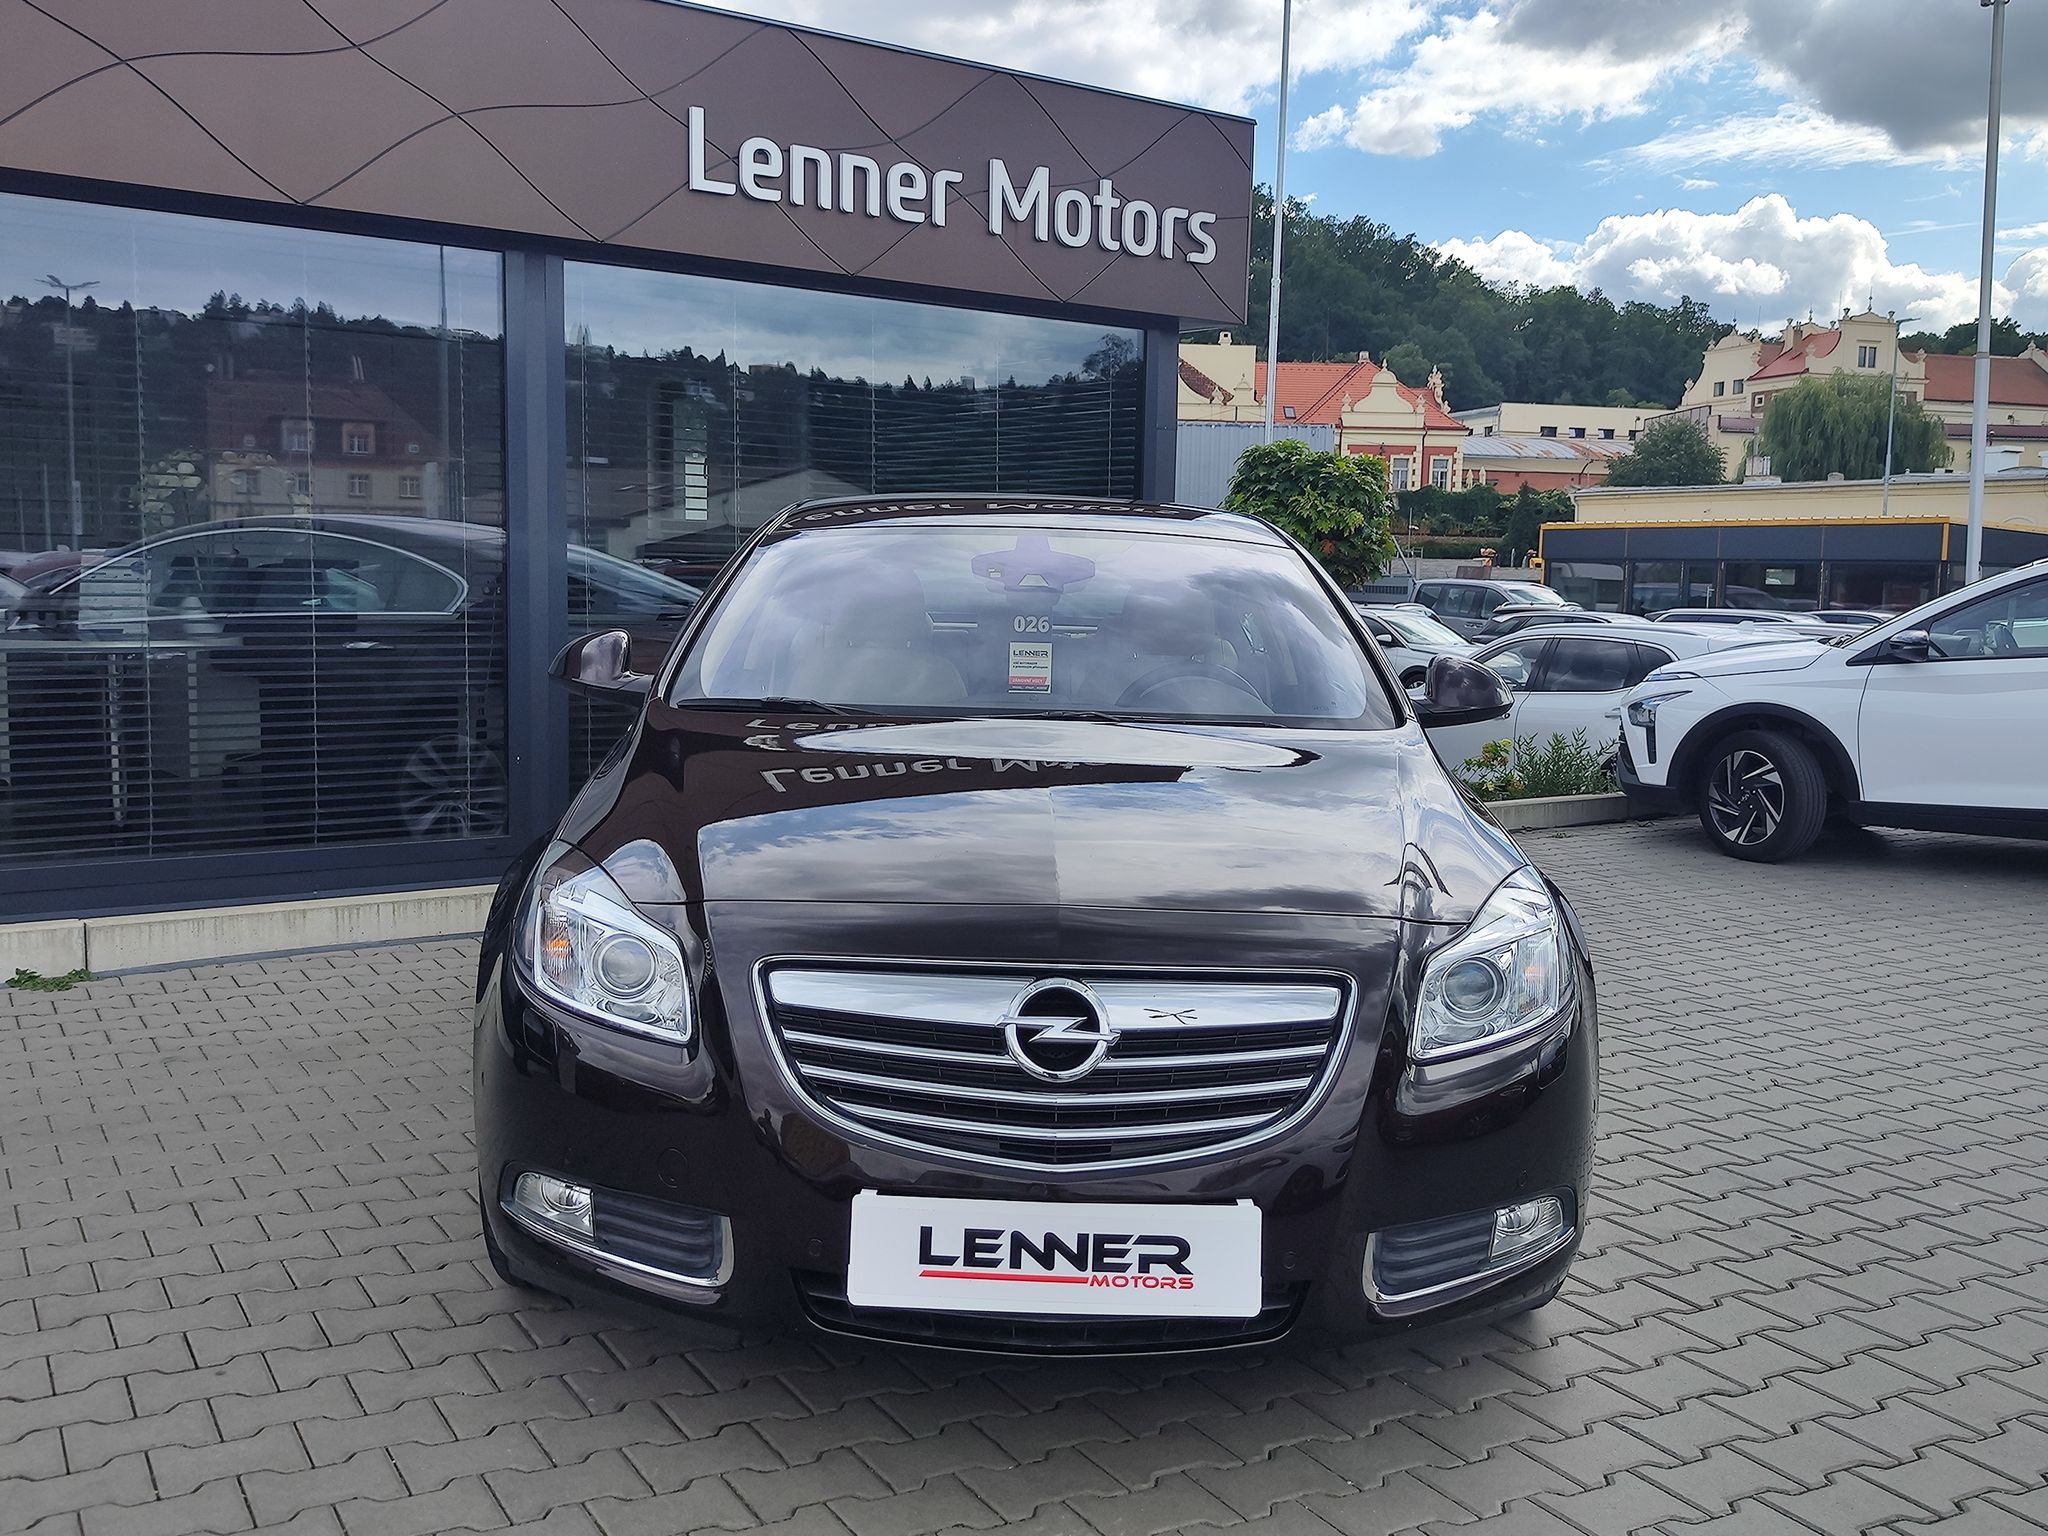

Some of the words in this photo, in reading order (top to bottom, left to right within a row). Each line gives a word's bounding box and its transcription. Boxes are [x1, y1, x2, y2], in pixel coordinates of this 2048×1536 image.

[688, 106, 963, 228] Lenner
[988, 158, 1217, 264] Motors
[1013, 615, 1050, 633] 026
[919, 1226, 1193, 1275] LENNER
[1090, 1274, 1194, 1290] MOTORS
